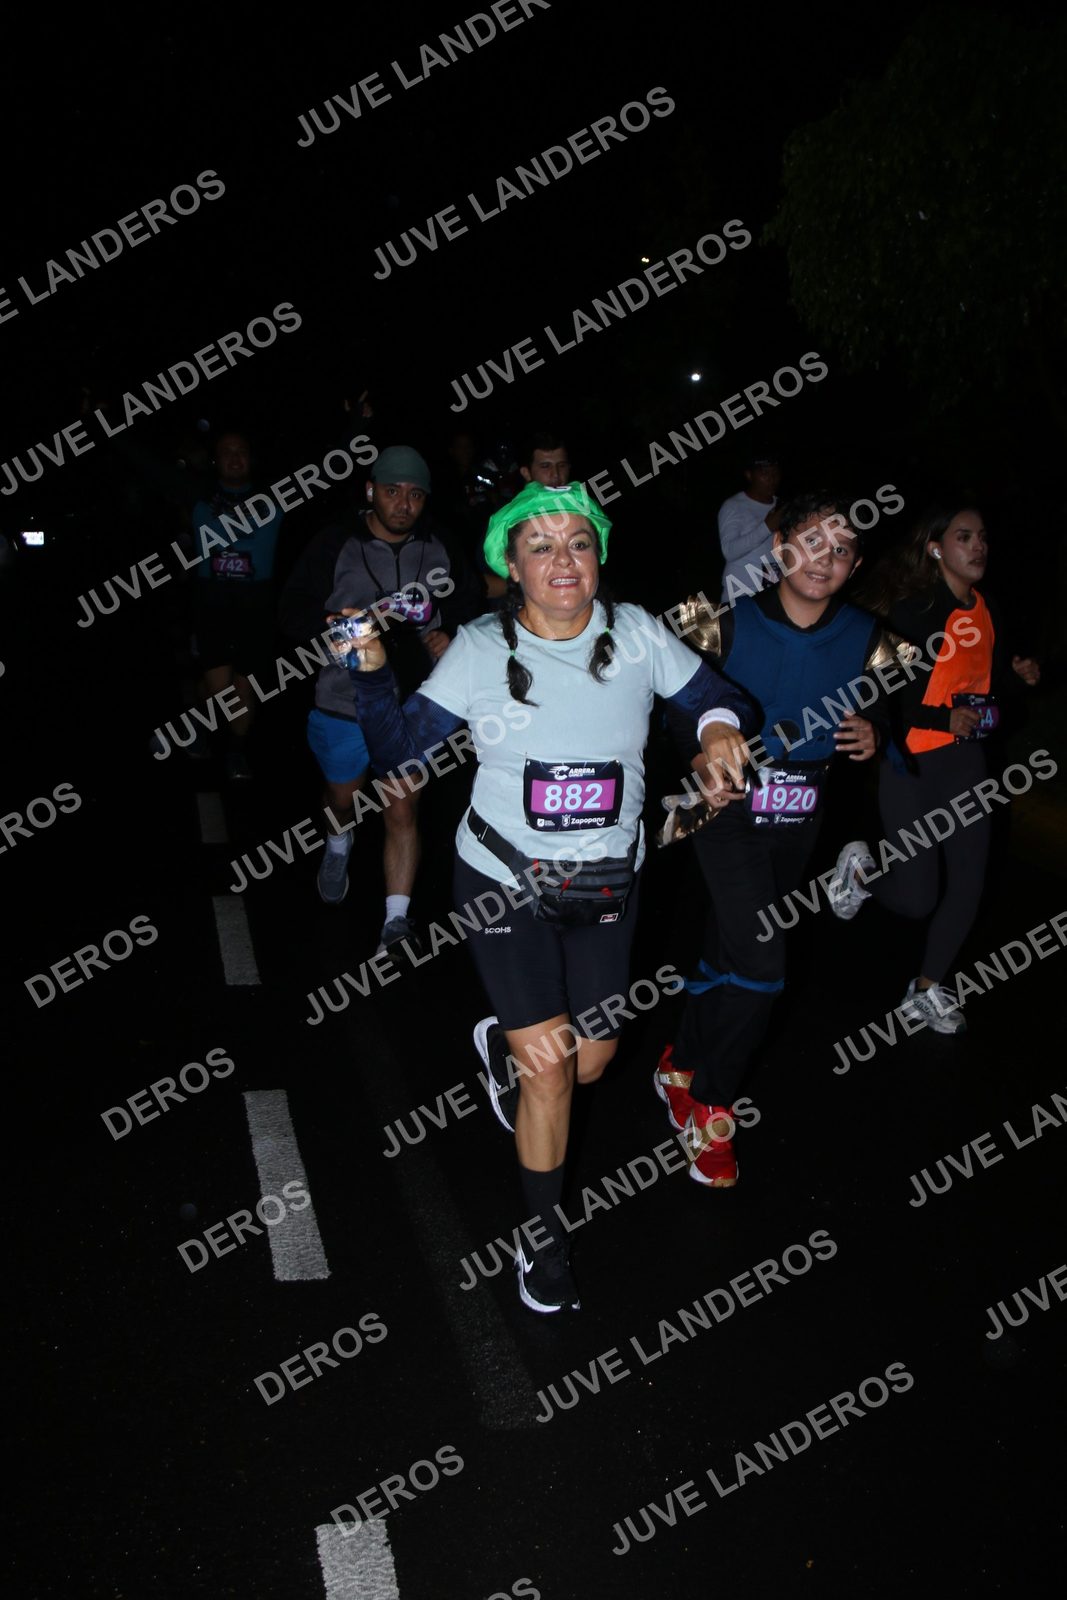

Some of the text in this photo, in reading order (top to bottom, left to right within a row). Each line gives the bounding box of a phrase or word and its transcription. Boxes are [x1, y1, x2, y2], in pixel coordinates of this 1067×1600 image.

[219, 560, 244, 570] 742
[544, 783, 603, 812] 882
[758, 786, 816, 810] 1920
